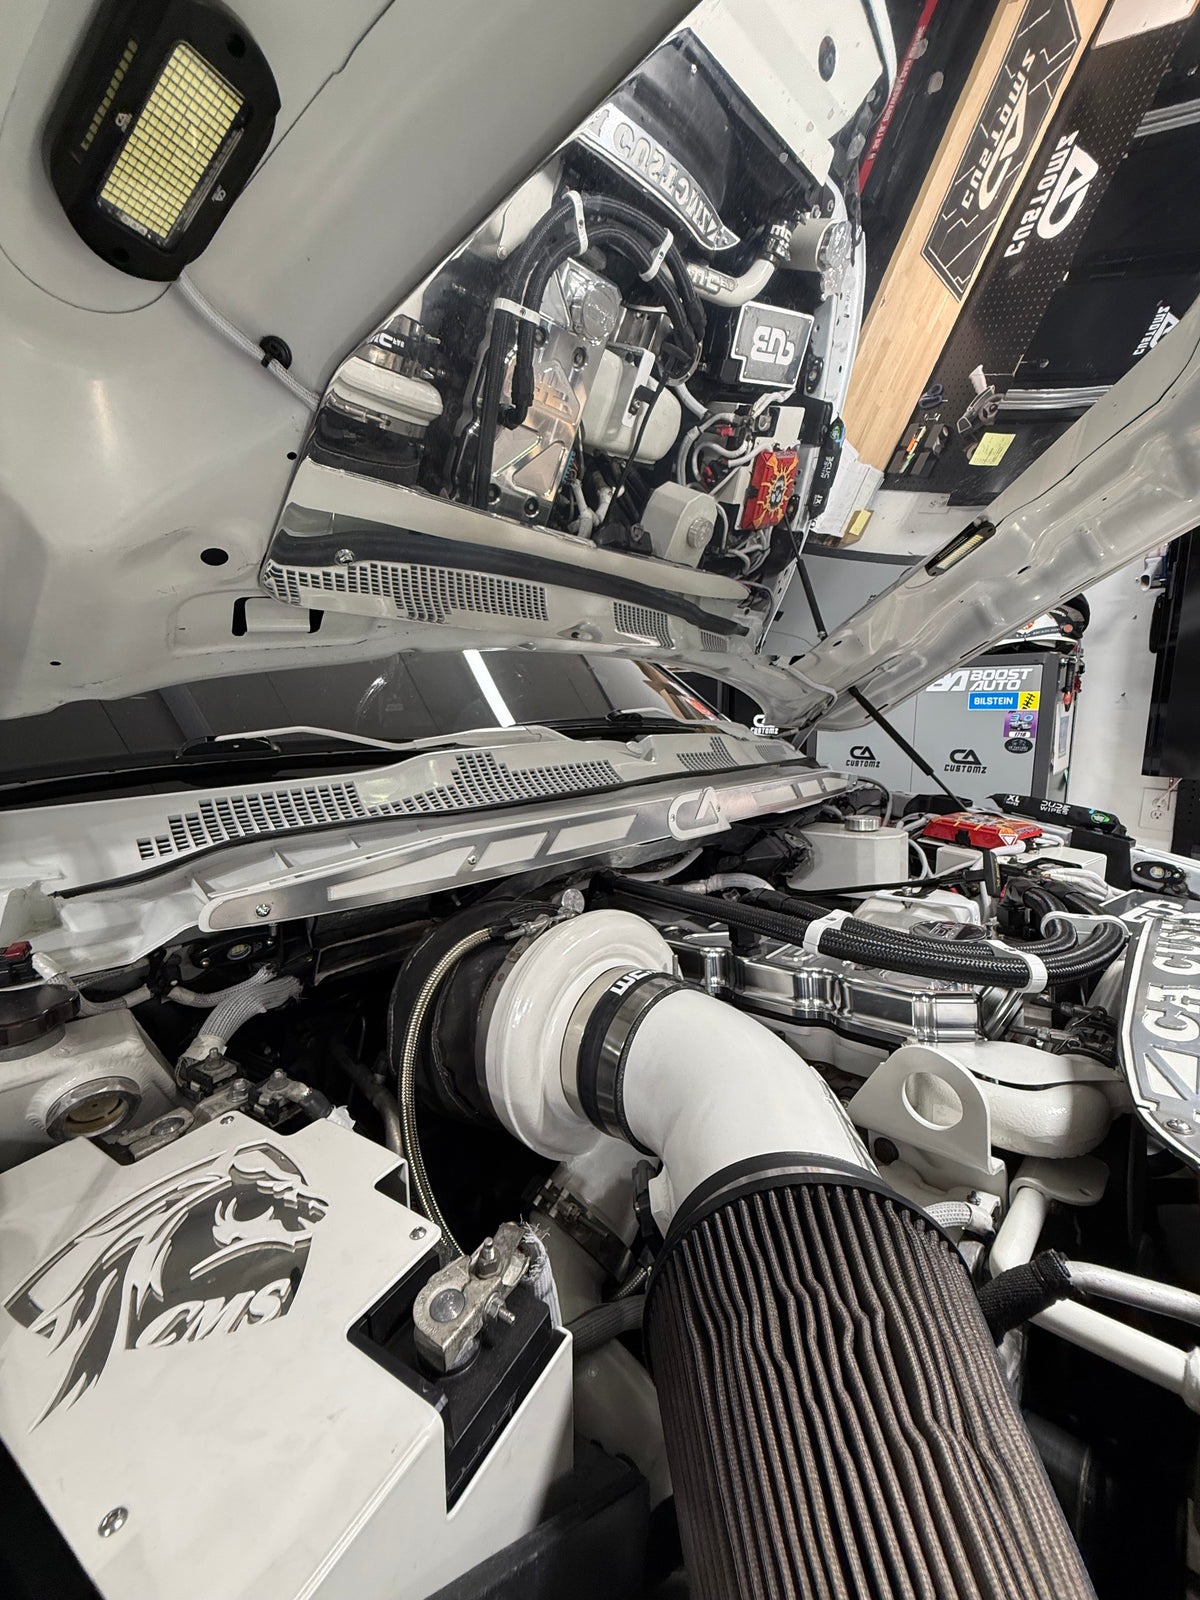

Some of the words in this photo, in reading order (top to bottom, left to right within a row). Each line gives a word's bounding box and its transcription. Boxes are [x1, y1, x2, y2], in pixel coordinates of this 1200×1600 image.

[969, 668, 1033, 680] BOOST
[969, 680, 1022, 691] AUTO
[974, 697, 1013, 706] BILSTEIN
[750, 727, 779, 735] CUSTOMZ
[850, 746, 876, 760] CA
[949, 749, 982, 765] CA
[846, 759, 881, 768] CUSTOMZ
[944, 764, 987, 774] CUSTOMZ
[1040, 806, 1069, 815] WIPES
[1041, 800, 1071, 811] DUDE
[667, 786, 732, 841] CA
